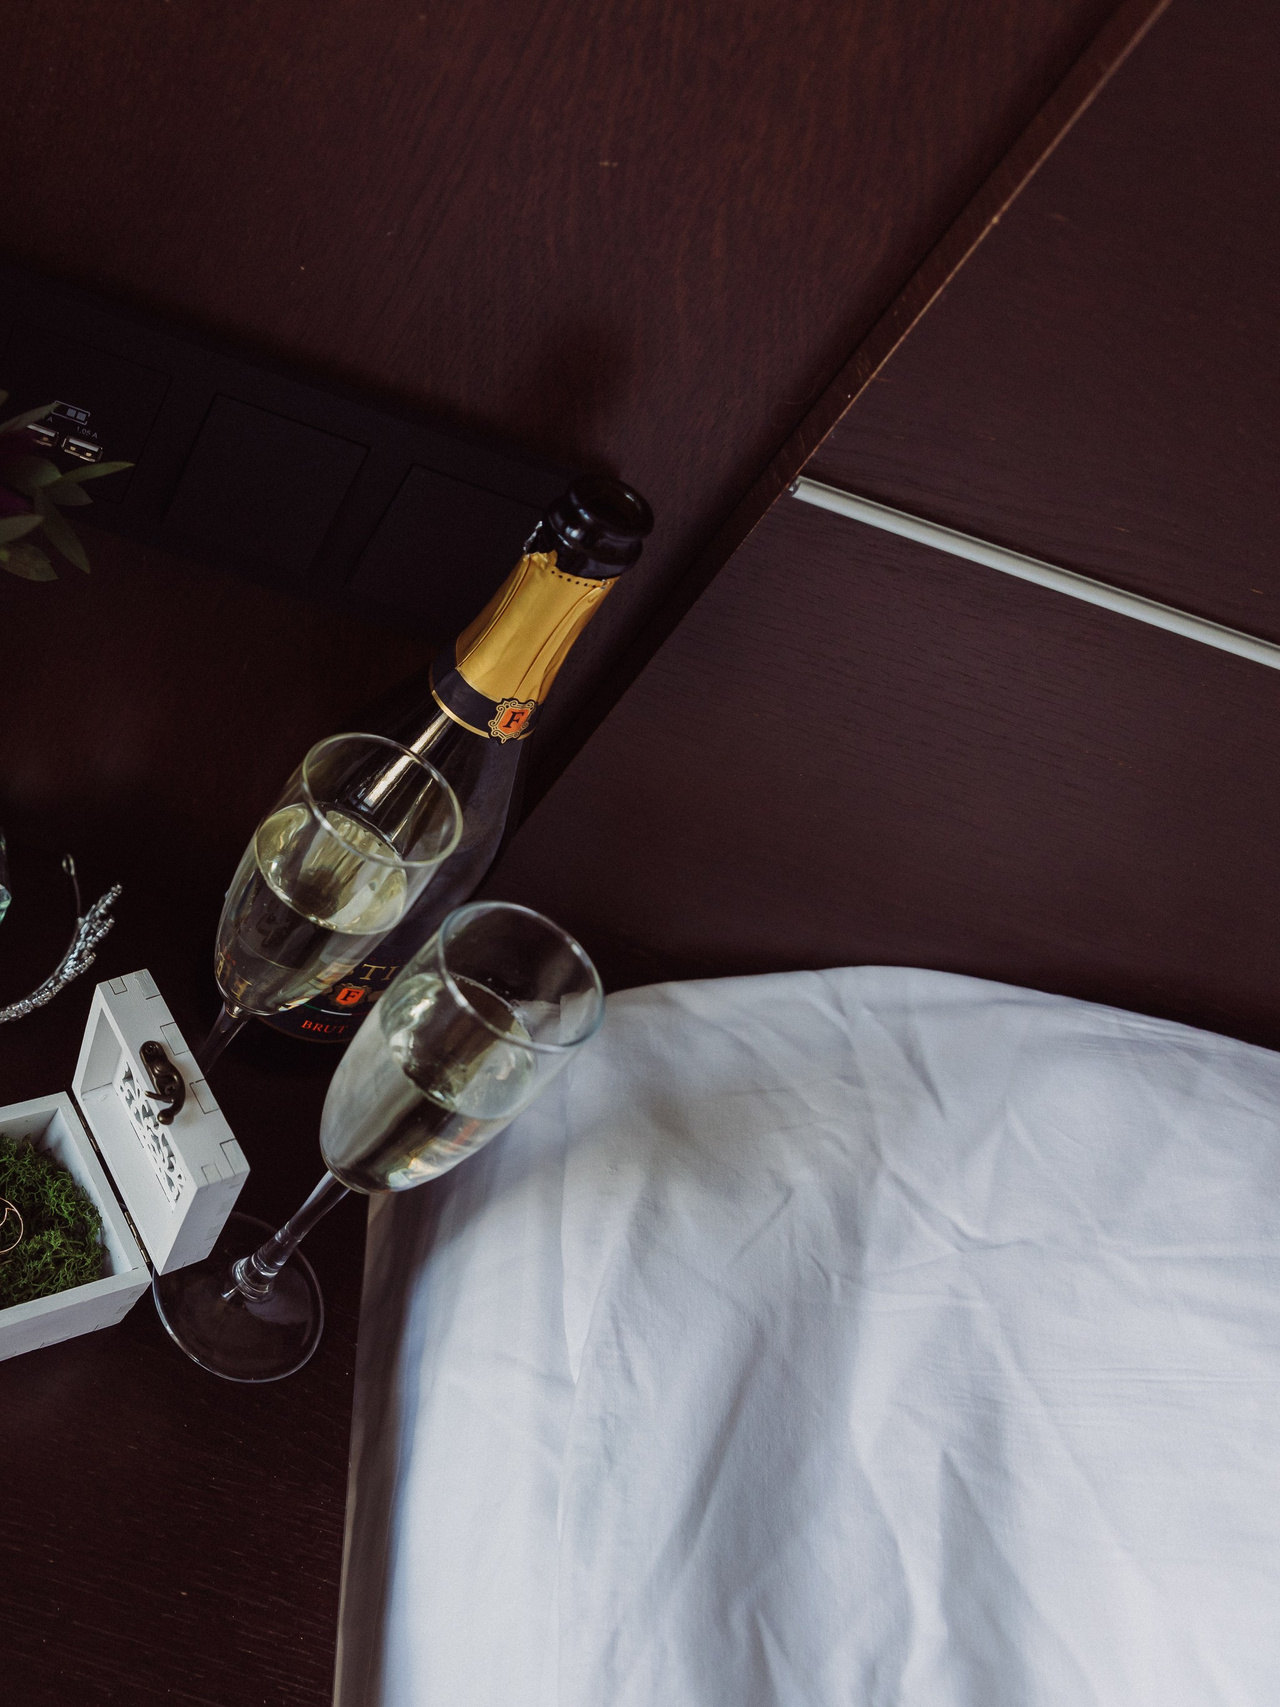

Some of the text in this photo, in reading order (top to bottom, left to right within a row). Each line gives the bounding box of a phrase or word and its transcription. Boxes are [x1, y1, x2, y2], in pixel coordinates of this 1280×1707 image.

[502, 710, 525, 729] F
[340, 989, 360, 1002] F
[301, 1019, 349, 1034] BRUT
